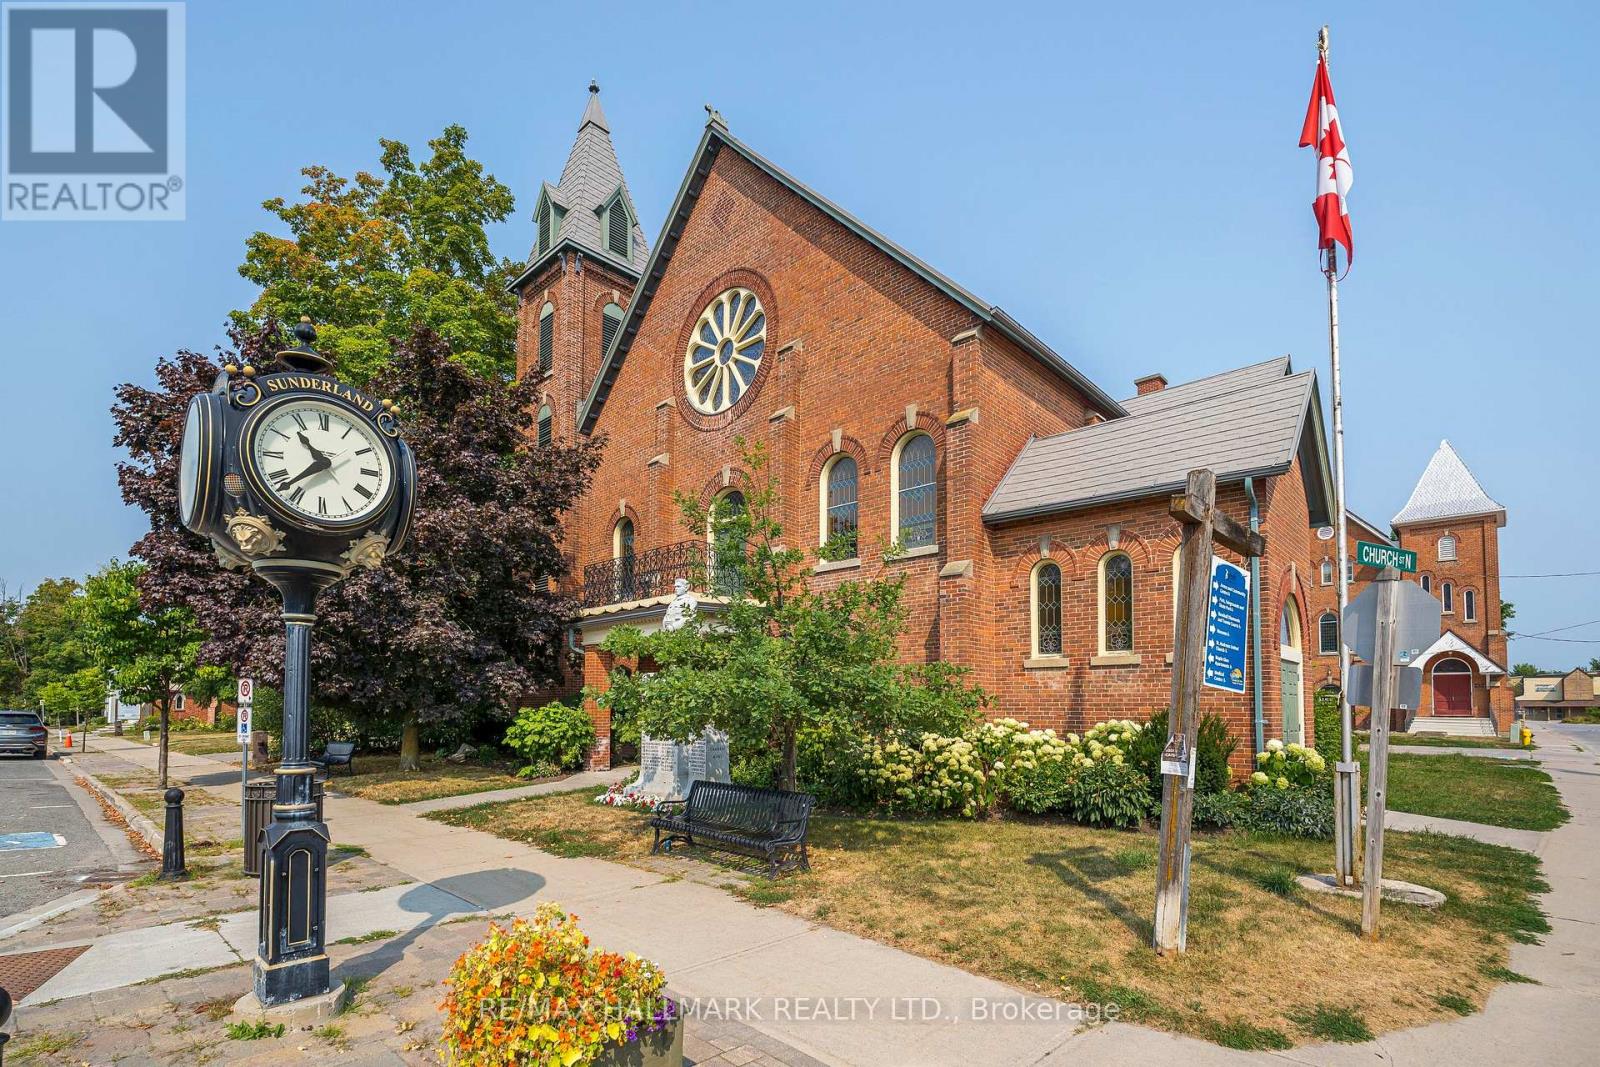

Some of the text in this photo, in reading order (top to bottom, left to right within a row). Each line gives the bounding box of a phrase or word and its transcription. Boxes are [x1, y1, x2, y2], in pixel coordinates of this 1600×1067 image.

[266, 376, 374, 411] SUNDERLAND
[1363, 545, 1412, 569] CHURCH ST N
